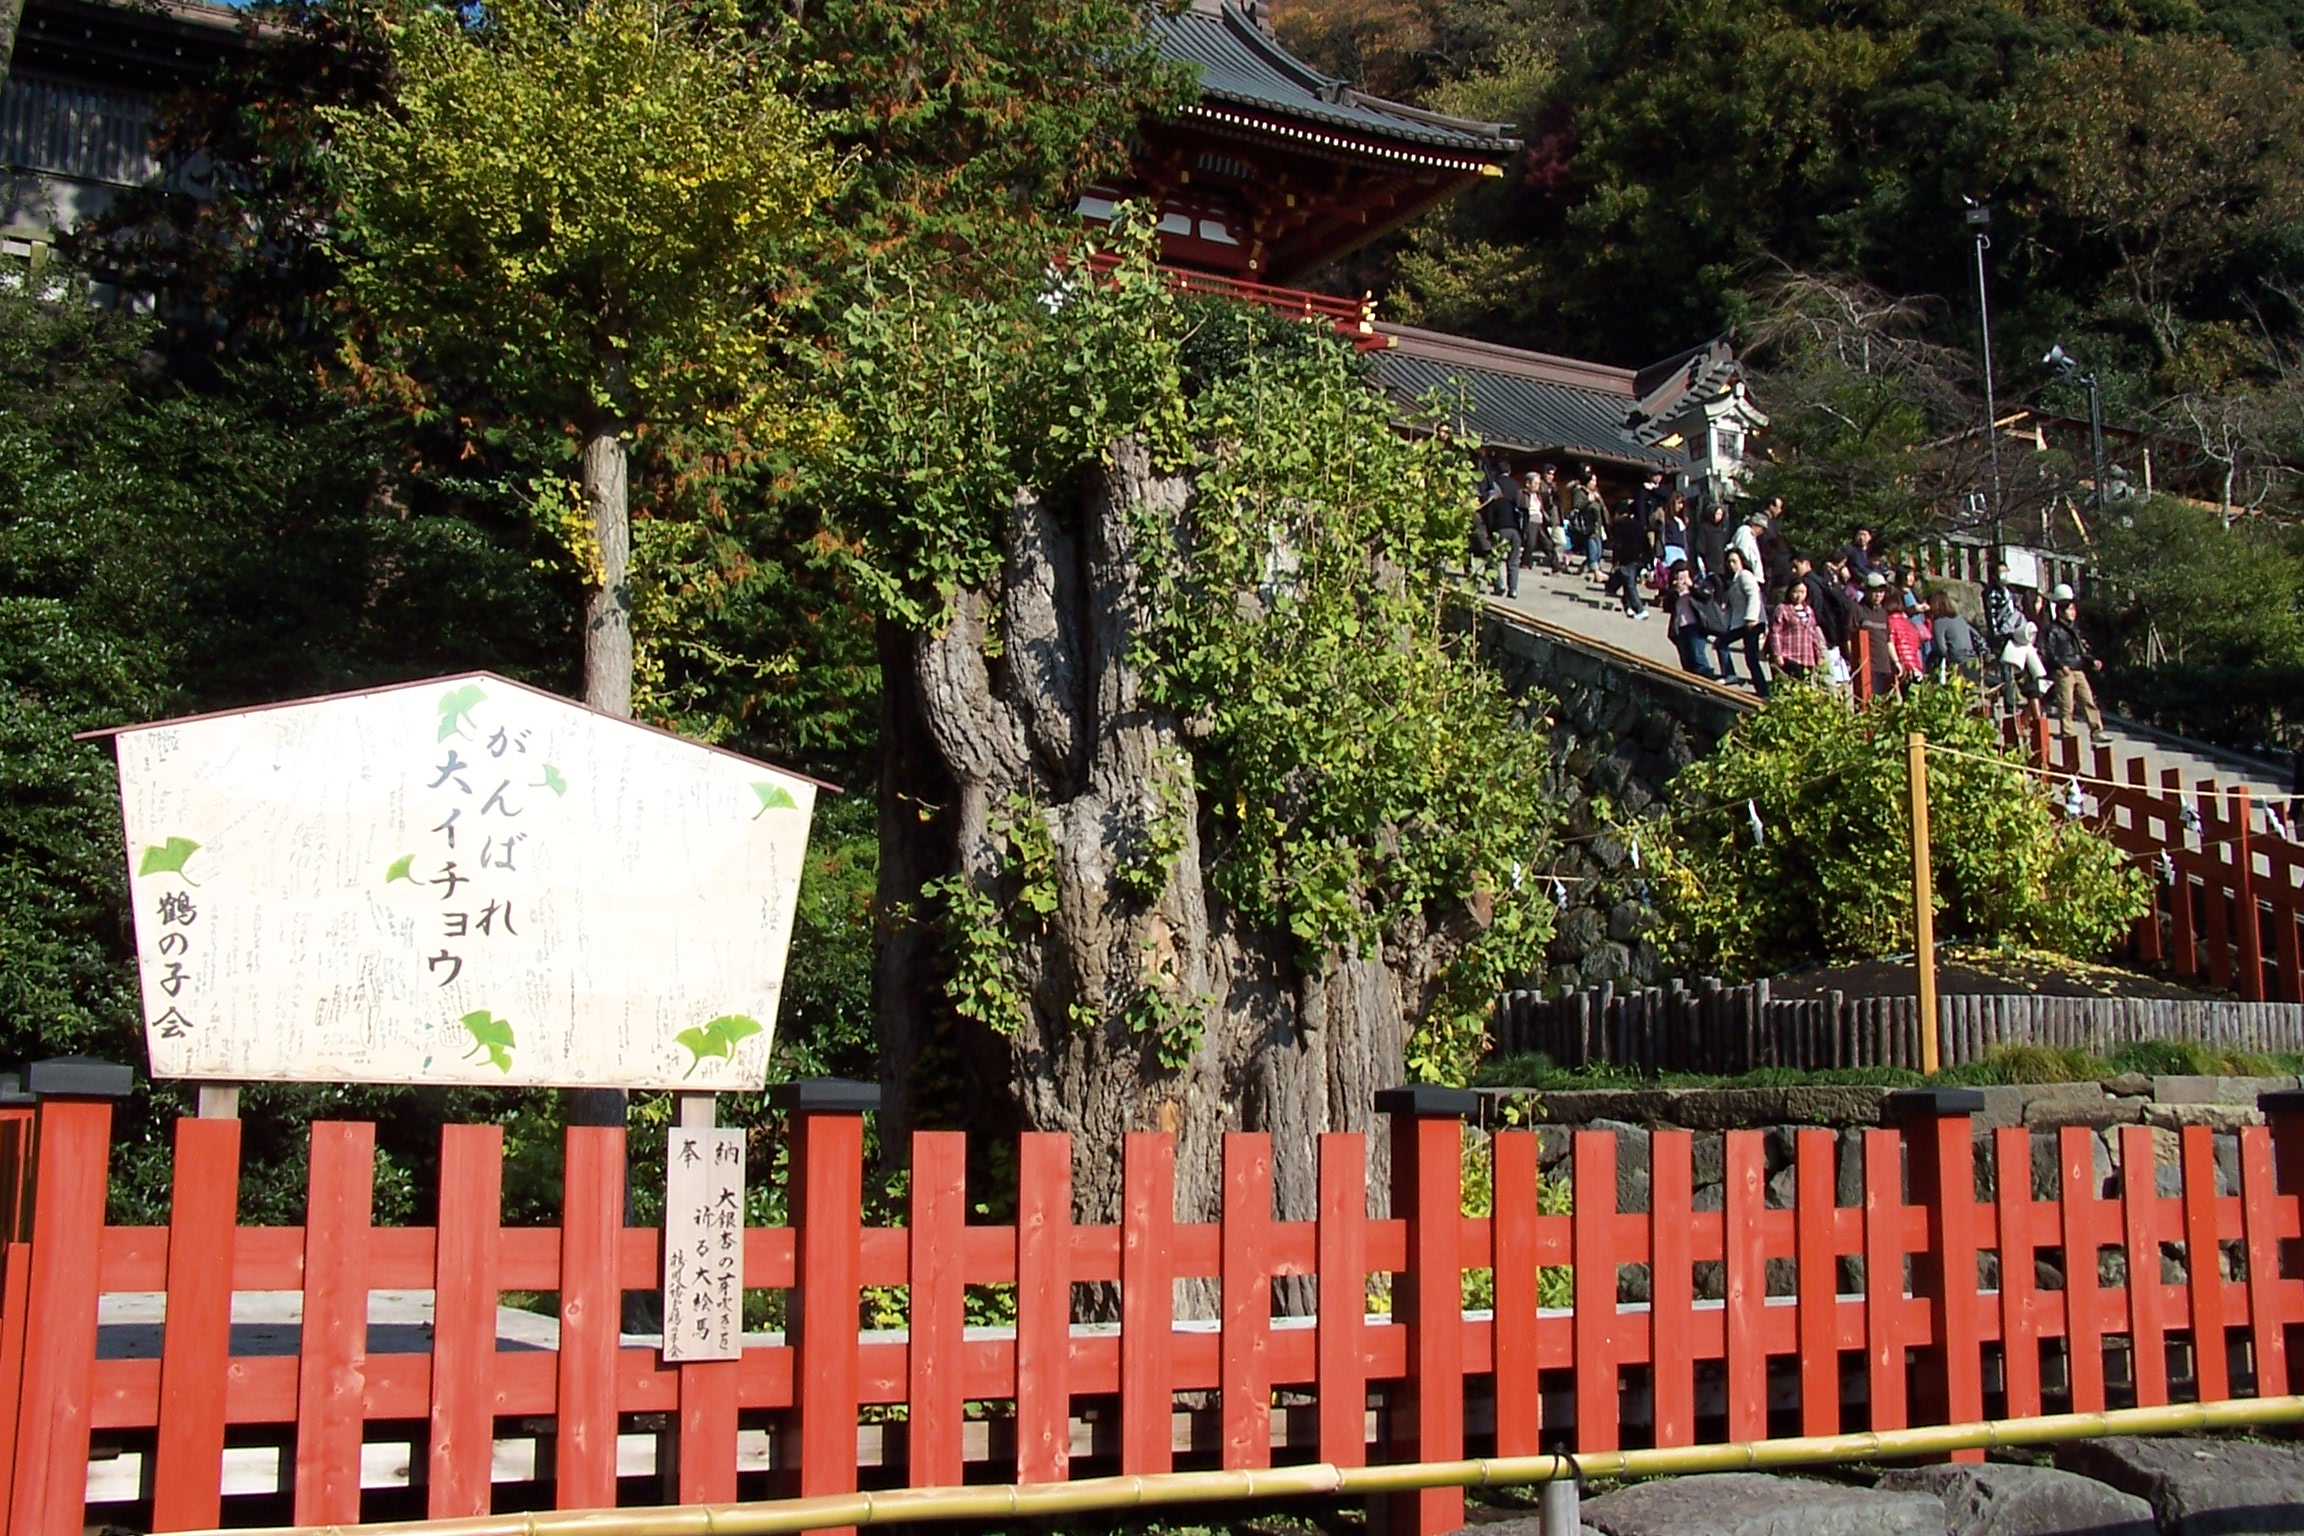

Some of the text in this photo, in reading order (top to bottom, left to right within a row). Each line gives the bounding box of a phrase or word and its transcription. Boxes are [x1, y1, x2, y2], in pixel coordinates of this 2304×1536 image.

[426, 748, 473, 988] 大イチョウ
[474, 725, 533, 937] がんばれ
[151, 890, 198, 1039] 鶴の子会
[693, 1205, 713, 1341] 祈る大絵馬
